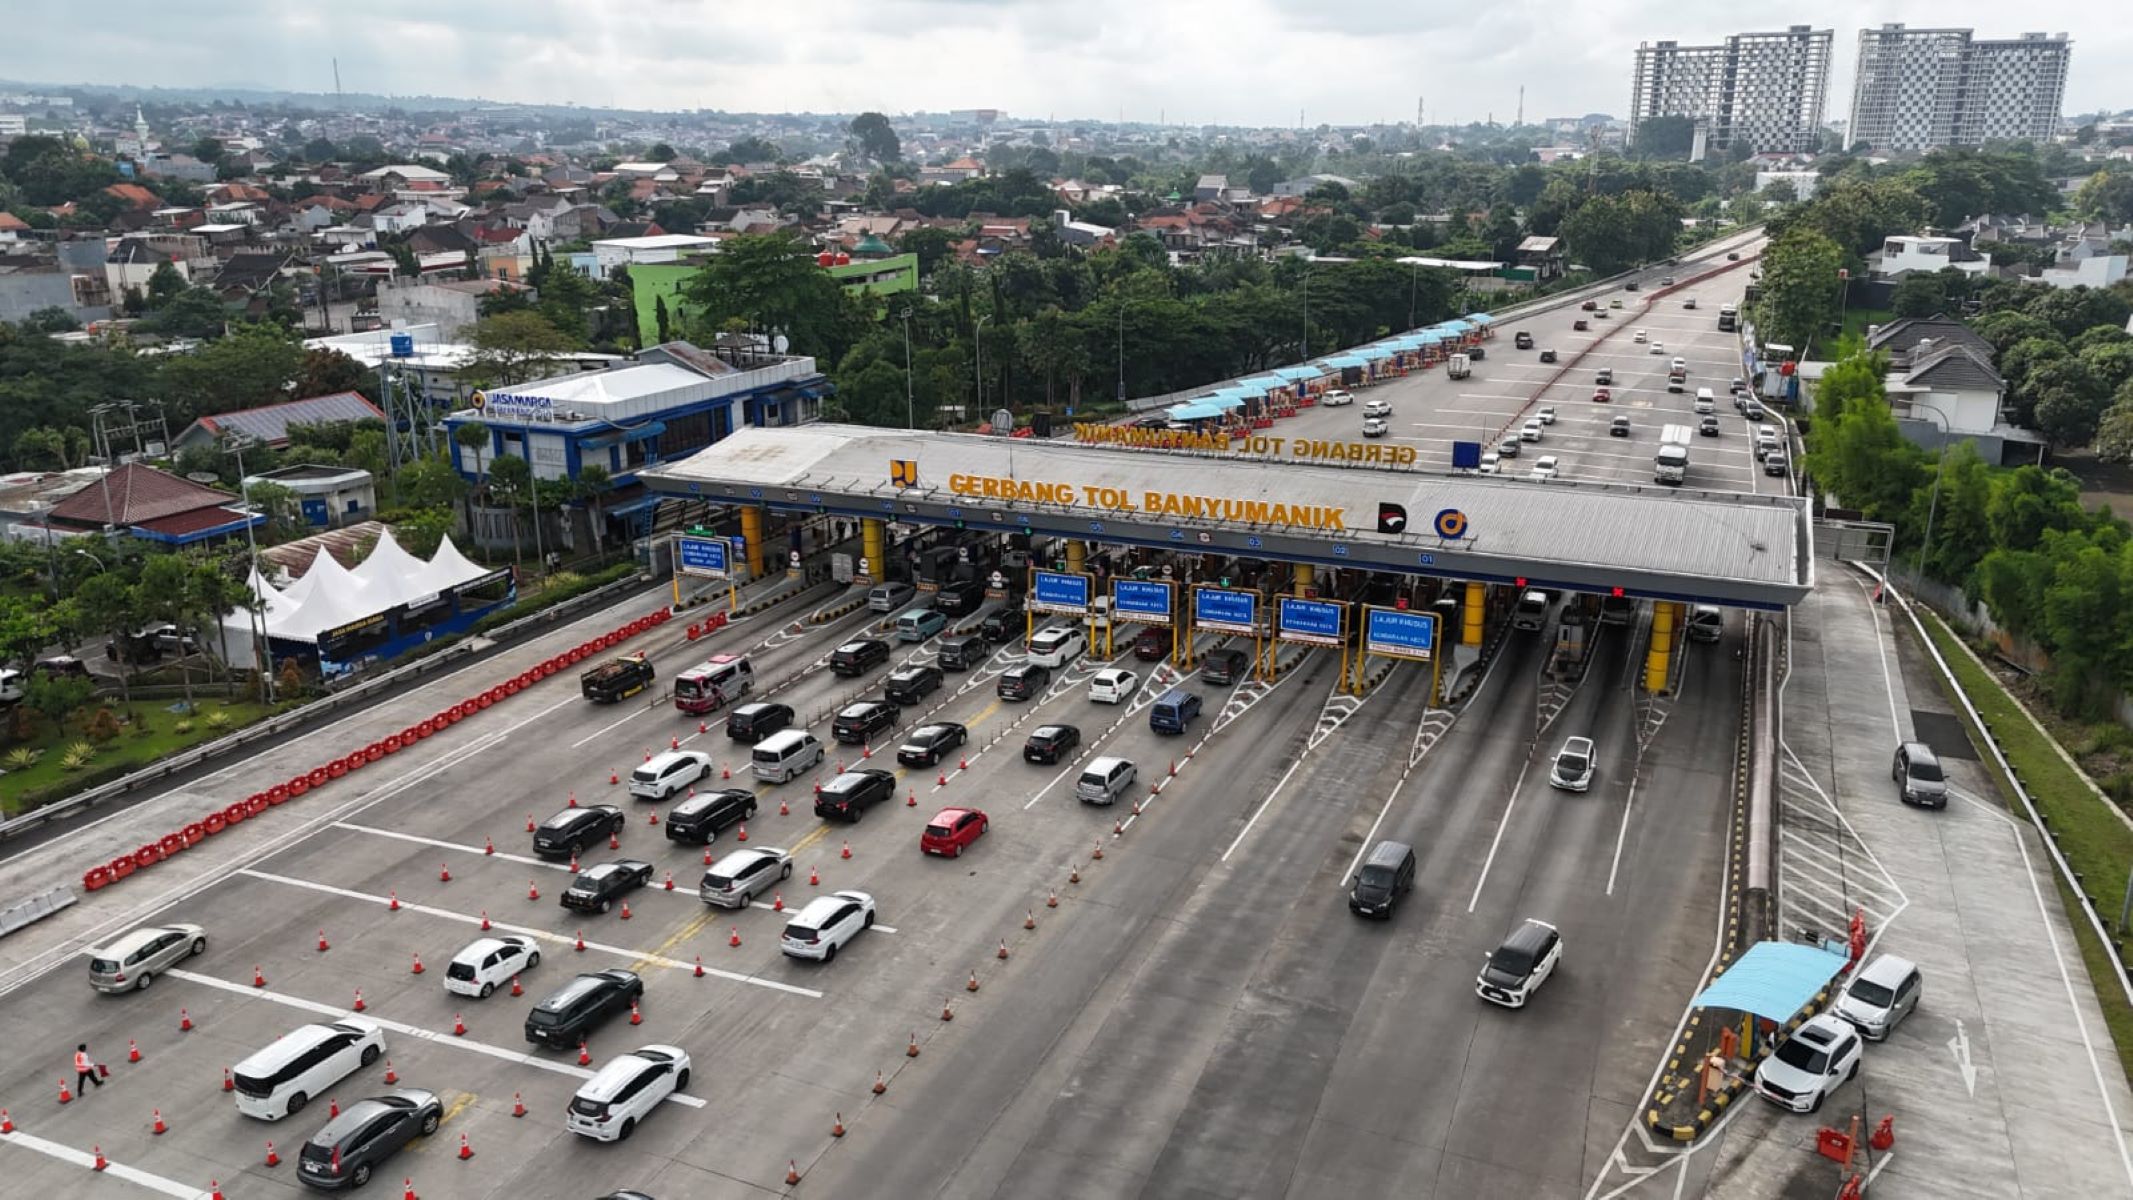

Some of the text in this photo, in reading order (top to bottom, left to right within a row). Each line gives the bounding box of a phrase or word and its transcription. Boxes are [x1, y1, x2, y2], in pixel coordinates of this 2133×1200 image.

[949, 473, 1345, 531] GERBANG TOL BANYUMANIK
[1421, 555, 1432, 563] 01
